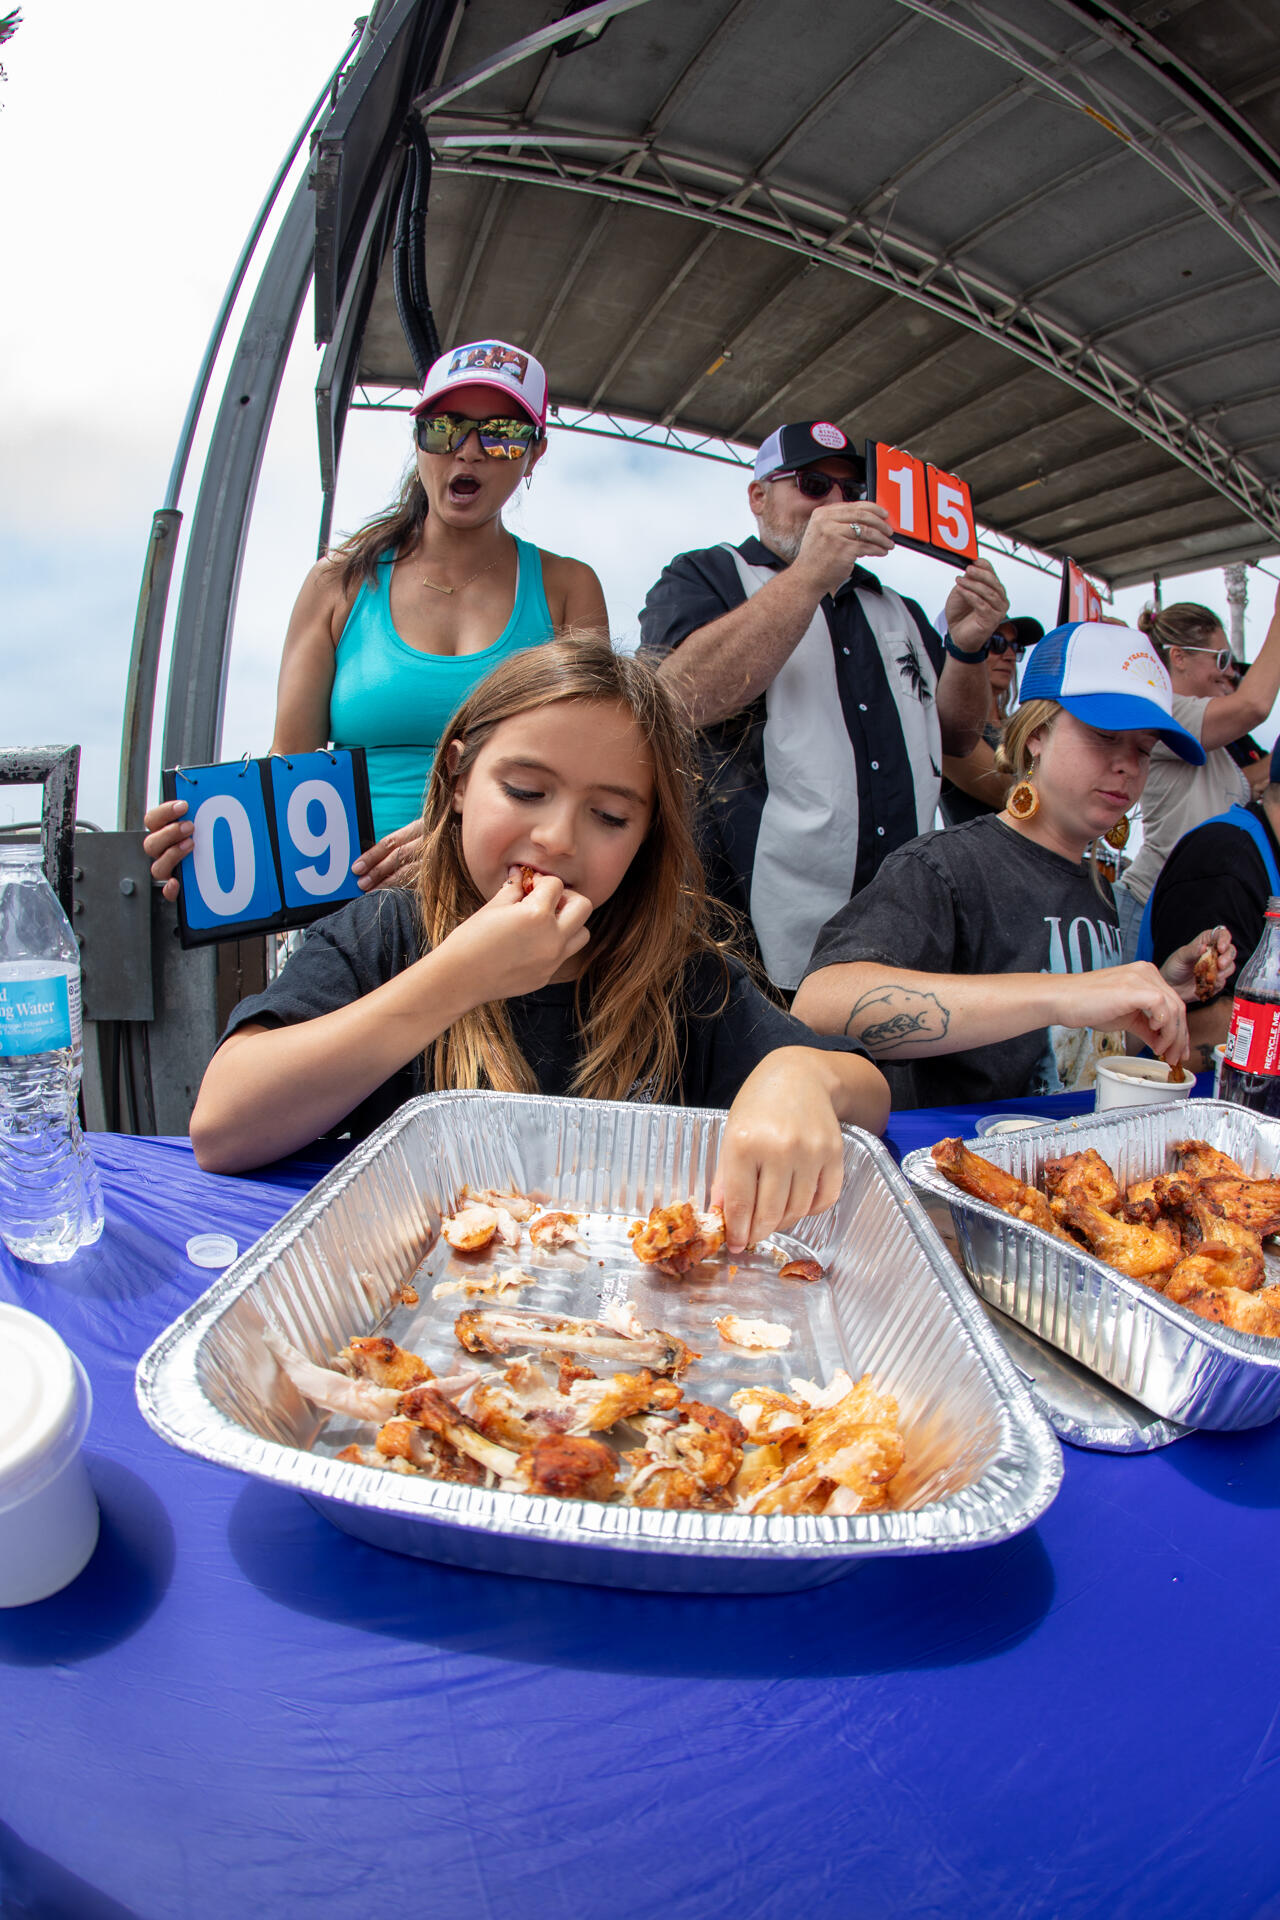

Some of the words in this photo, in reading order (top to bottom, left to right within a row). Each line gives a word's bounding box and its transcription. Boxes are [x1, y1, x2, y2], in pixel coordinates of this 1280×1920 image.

[16, 1001, 55, 1017] Water
[1264, 1027, 1278, 1070] RECYCLE
[1271, 1011, 1280, 1027] ME
